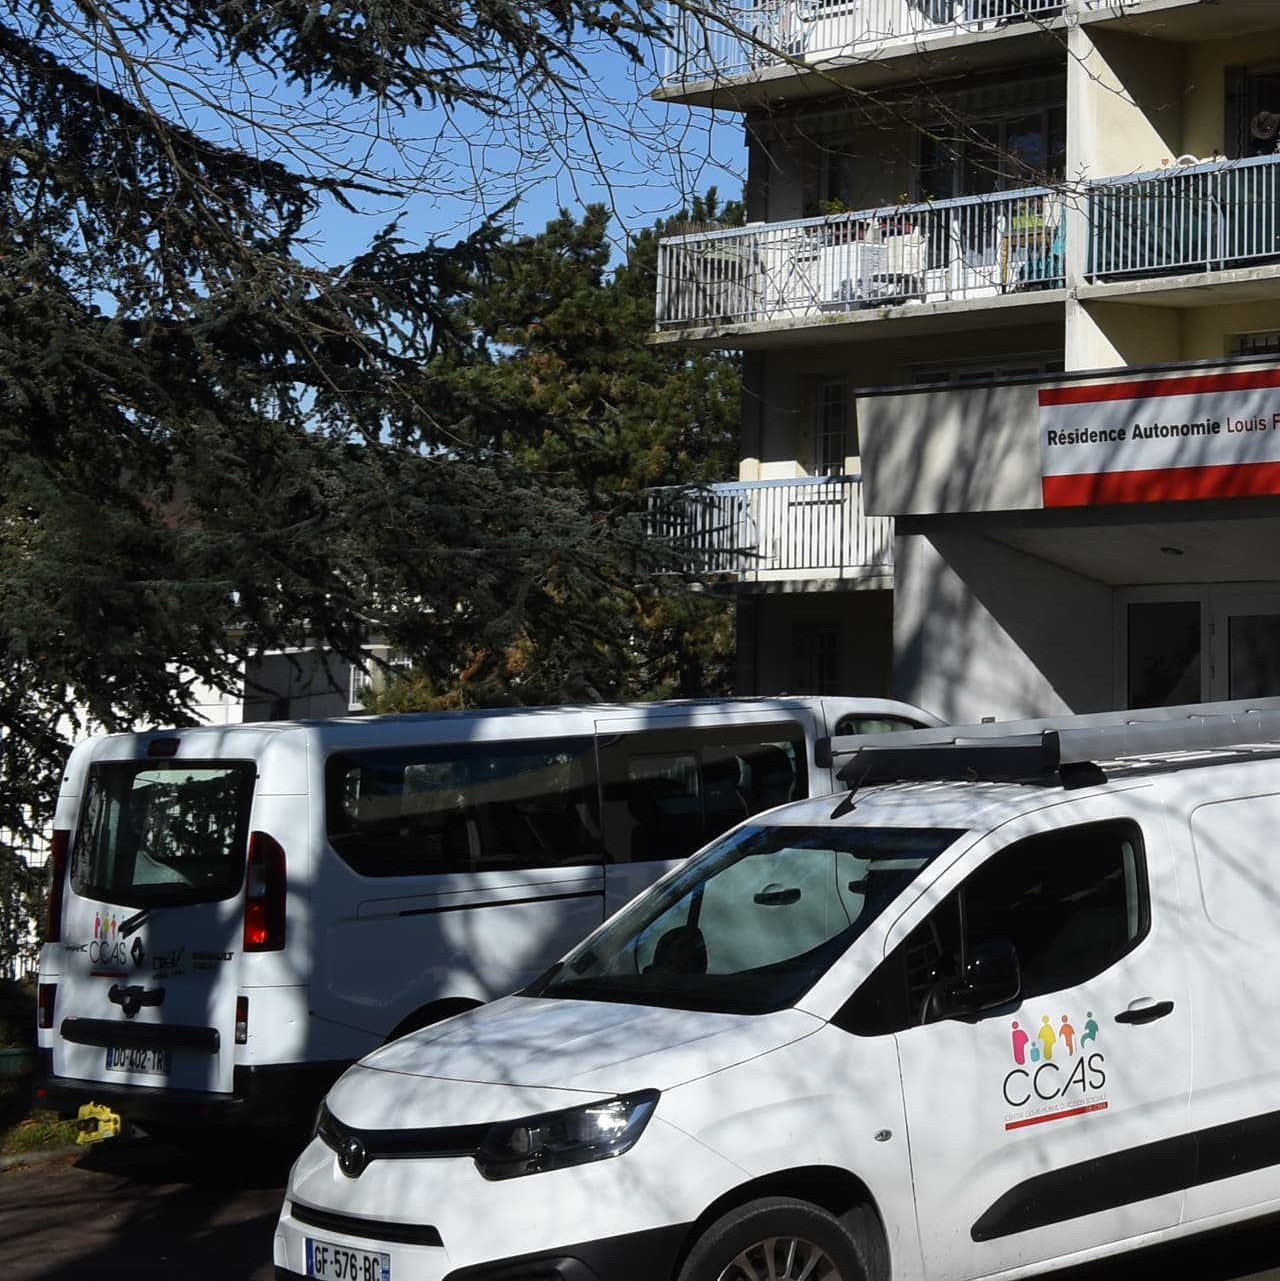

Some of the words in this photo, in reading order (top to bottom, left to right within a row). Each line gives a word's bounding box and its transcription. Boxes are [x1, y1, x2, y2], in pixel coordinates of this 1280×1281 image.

[1047, 427, 1126, 446] Résidence
[1131, 418, 1221, 440] Autonomie
[1226, 416, 1267, 433] Louis
[90, 941, 127, 965] CCAS
[1003, 1053, 1106, 1107] CCAS
[314, 1244, 380, 1281] GF-576-BC
